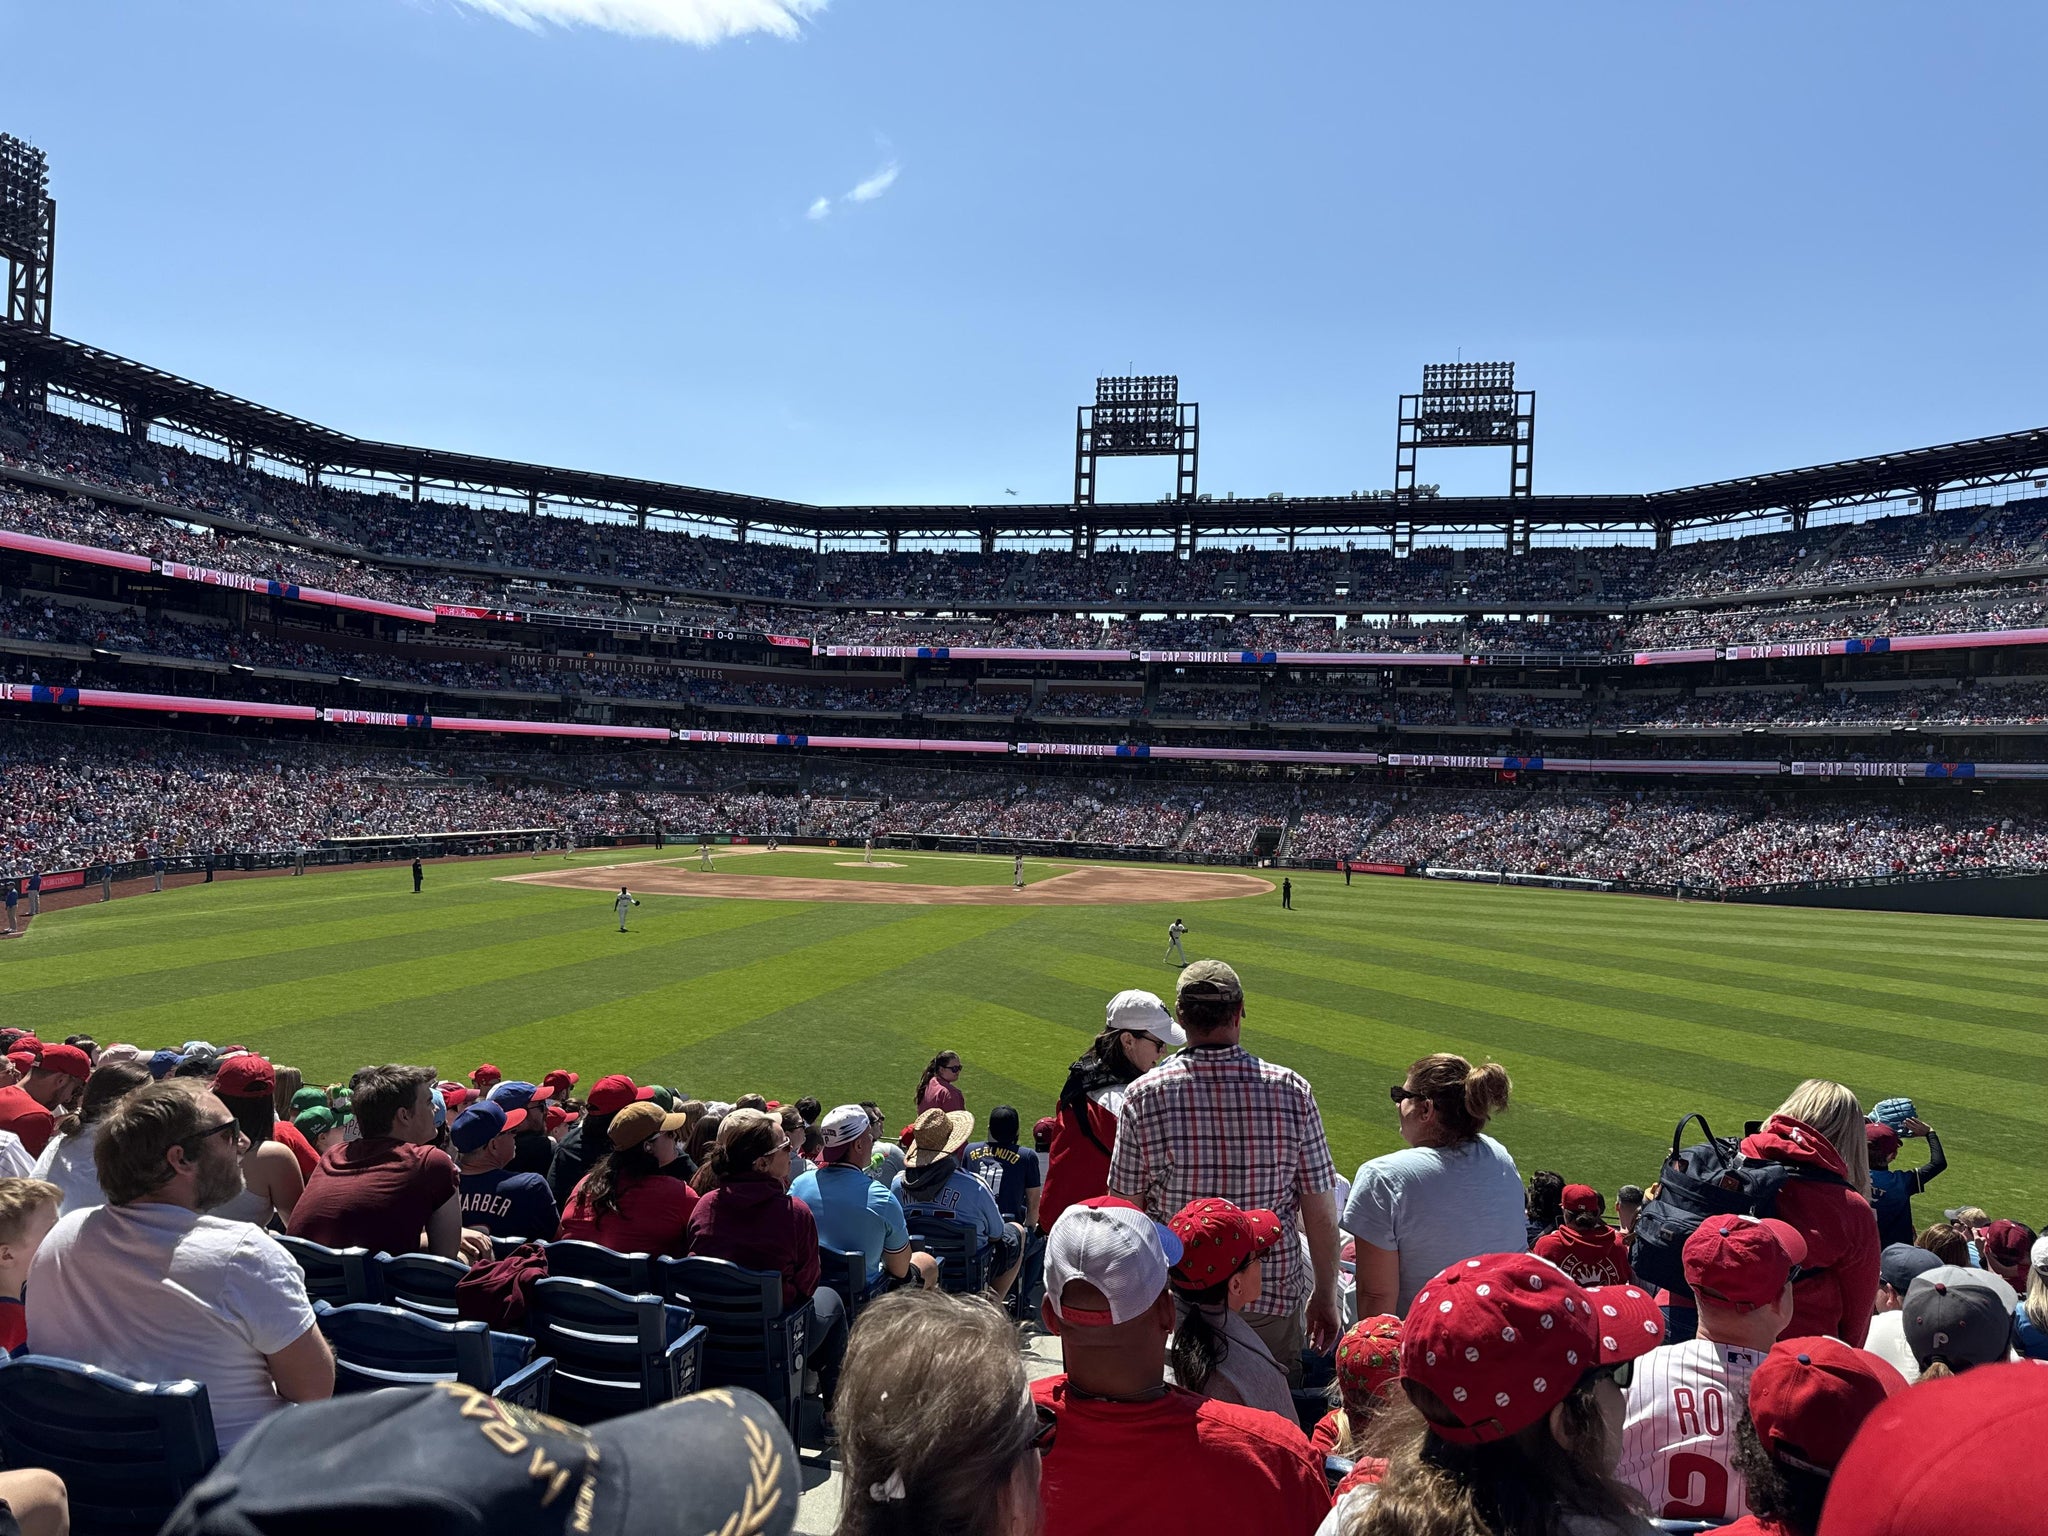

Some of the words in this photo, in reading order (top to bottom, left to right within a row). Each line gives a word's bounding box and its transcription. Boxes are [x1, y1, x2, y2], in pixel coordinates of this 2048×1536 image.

[186, 566, 207, 582] CAP
[215, 571, 256, 591] SHUFFLE
[846, 646, 863, 656] CAP
[870, 647, 906, 657] SHUFFLE
[1162, 652, 1180, 661] CAP
[1189, 652, 1228, 662] SHUFFLE
[1751, 646, 1771, 658] CAP
[1782, 642, 1830, 656] SHUFFLE
[511, 654, 542, 666] HOME
[548, 658, 562, 668] OF
[569, 659, 588, 670] THE
[343, 710, 359, 723] CAP
[366, 712, 398, 726] SHUFFLE
[701, 731, 720, 742] CAP
[727, 733, 765, 744] SHUFFLE
[1039, 744, 1057, 754] CAP
[1064, 744, 1104, 755] SHUFFLE
[1413, 755, 1434, 766] CAP
[1443, 756, 1488, 768] SHUFFLE
[1819, 762, 1843, 776] CAP
[1854, 763, 1908, 776] SHUFFLE
[970, 1146, 1020, 1165] REALMUTO
[979, 1158, 1004, 1199] 10
[460, 1193, 511, 1217] ARBER
[1933, 1332, 1949, 1348] P
